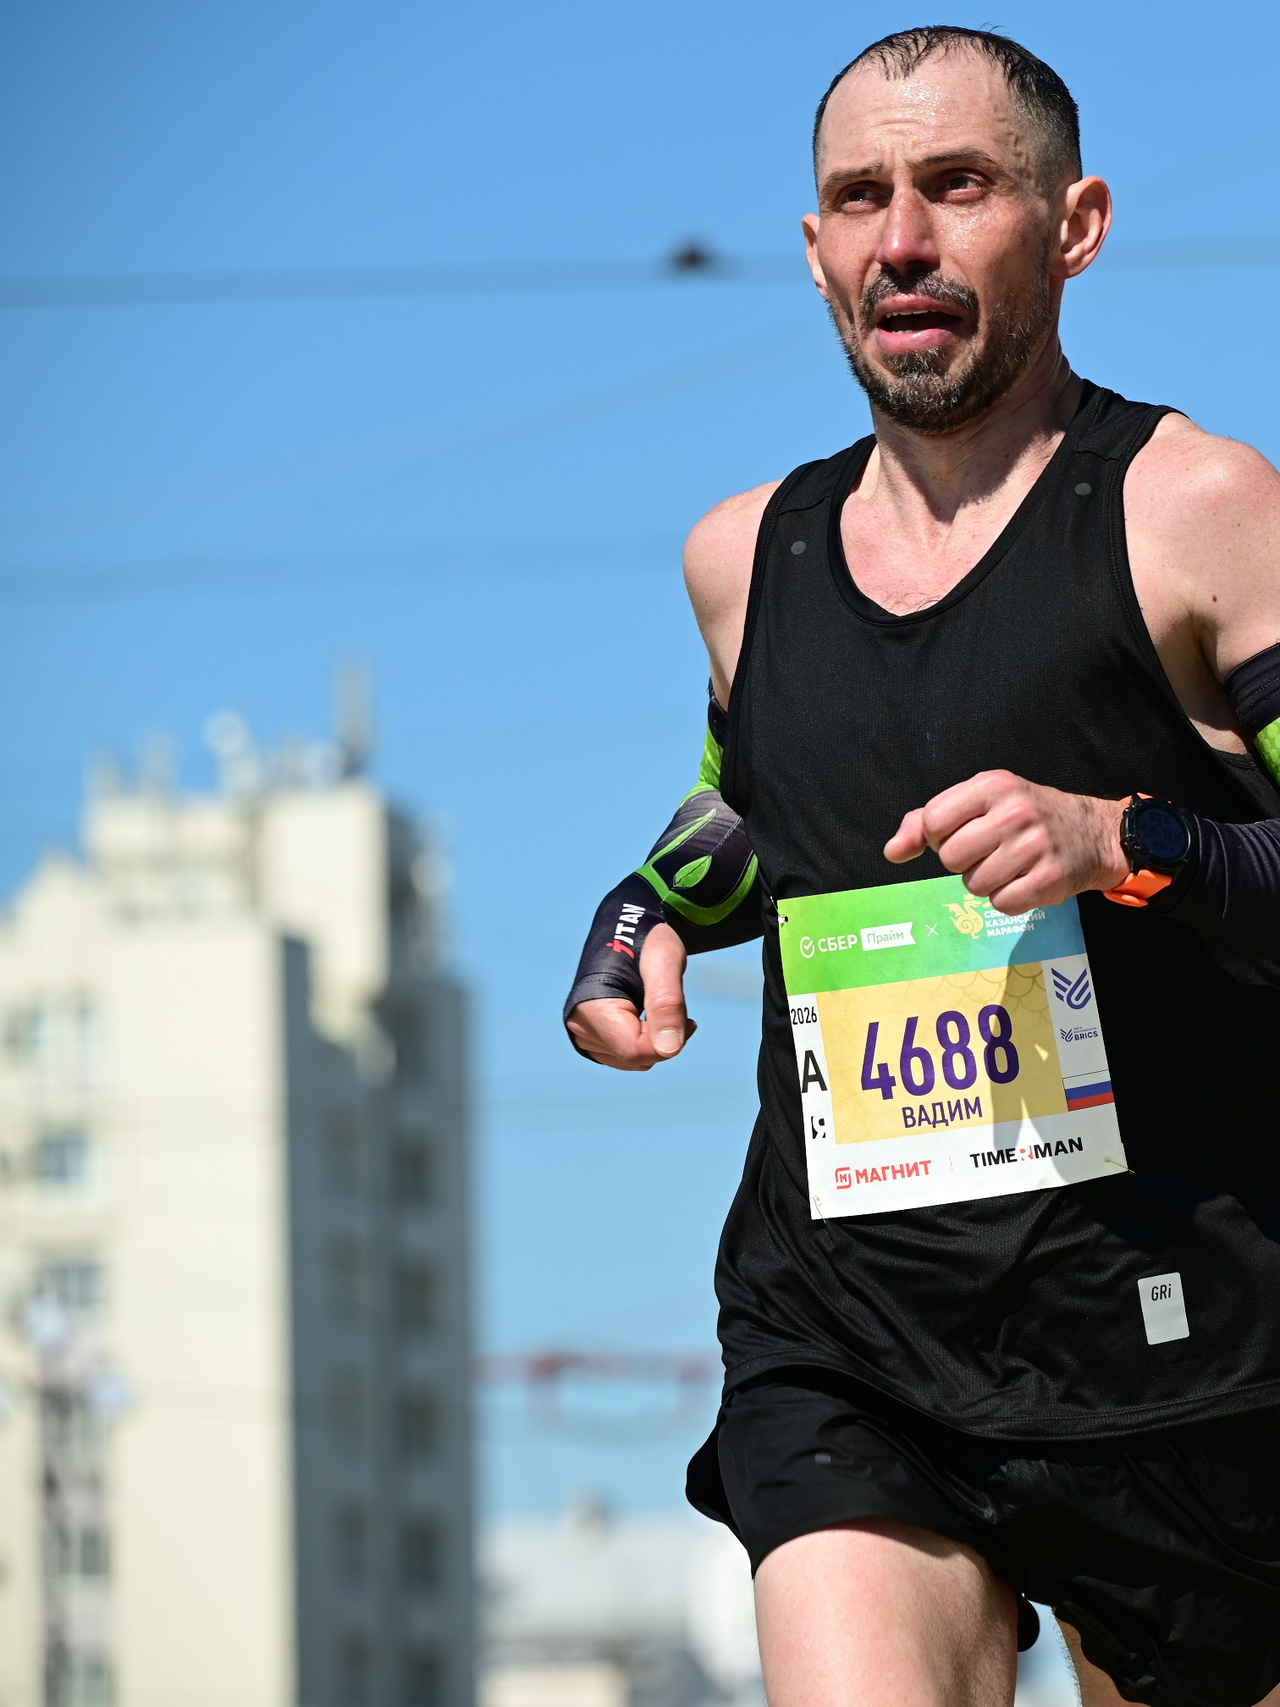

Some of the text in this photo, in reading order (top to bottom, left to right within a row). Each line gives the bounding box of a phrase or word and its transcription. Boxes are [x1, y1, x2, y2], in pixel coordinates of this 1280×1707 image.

[985, 910, 1046, 928] КАЗАНСКИЙ
[986, 922, 1035, 938] МАРАФОН
[818, 930, 905, 953] СБЕР Прайм
[790, 1007, 818, 1025] 2026
[1074, 1030, 1099, 1041] BRICS
[860, 1004, 1020, 1101] 4688
[901, 1095, 984, 1129] ВАДИМ
[855, 1159, 932, 1185] МАГНИТ
[1151, 1284, 1172, 1302] GRi
